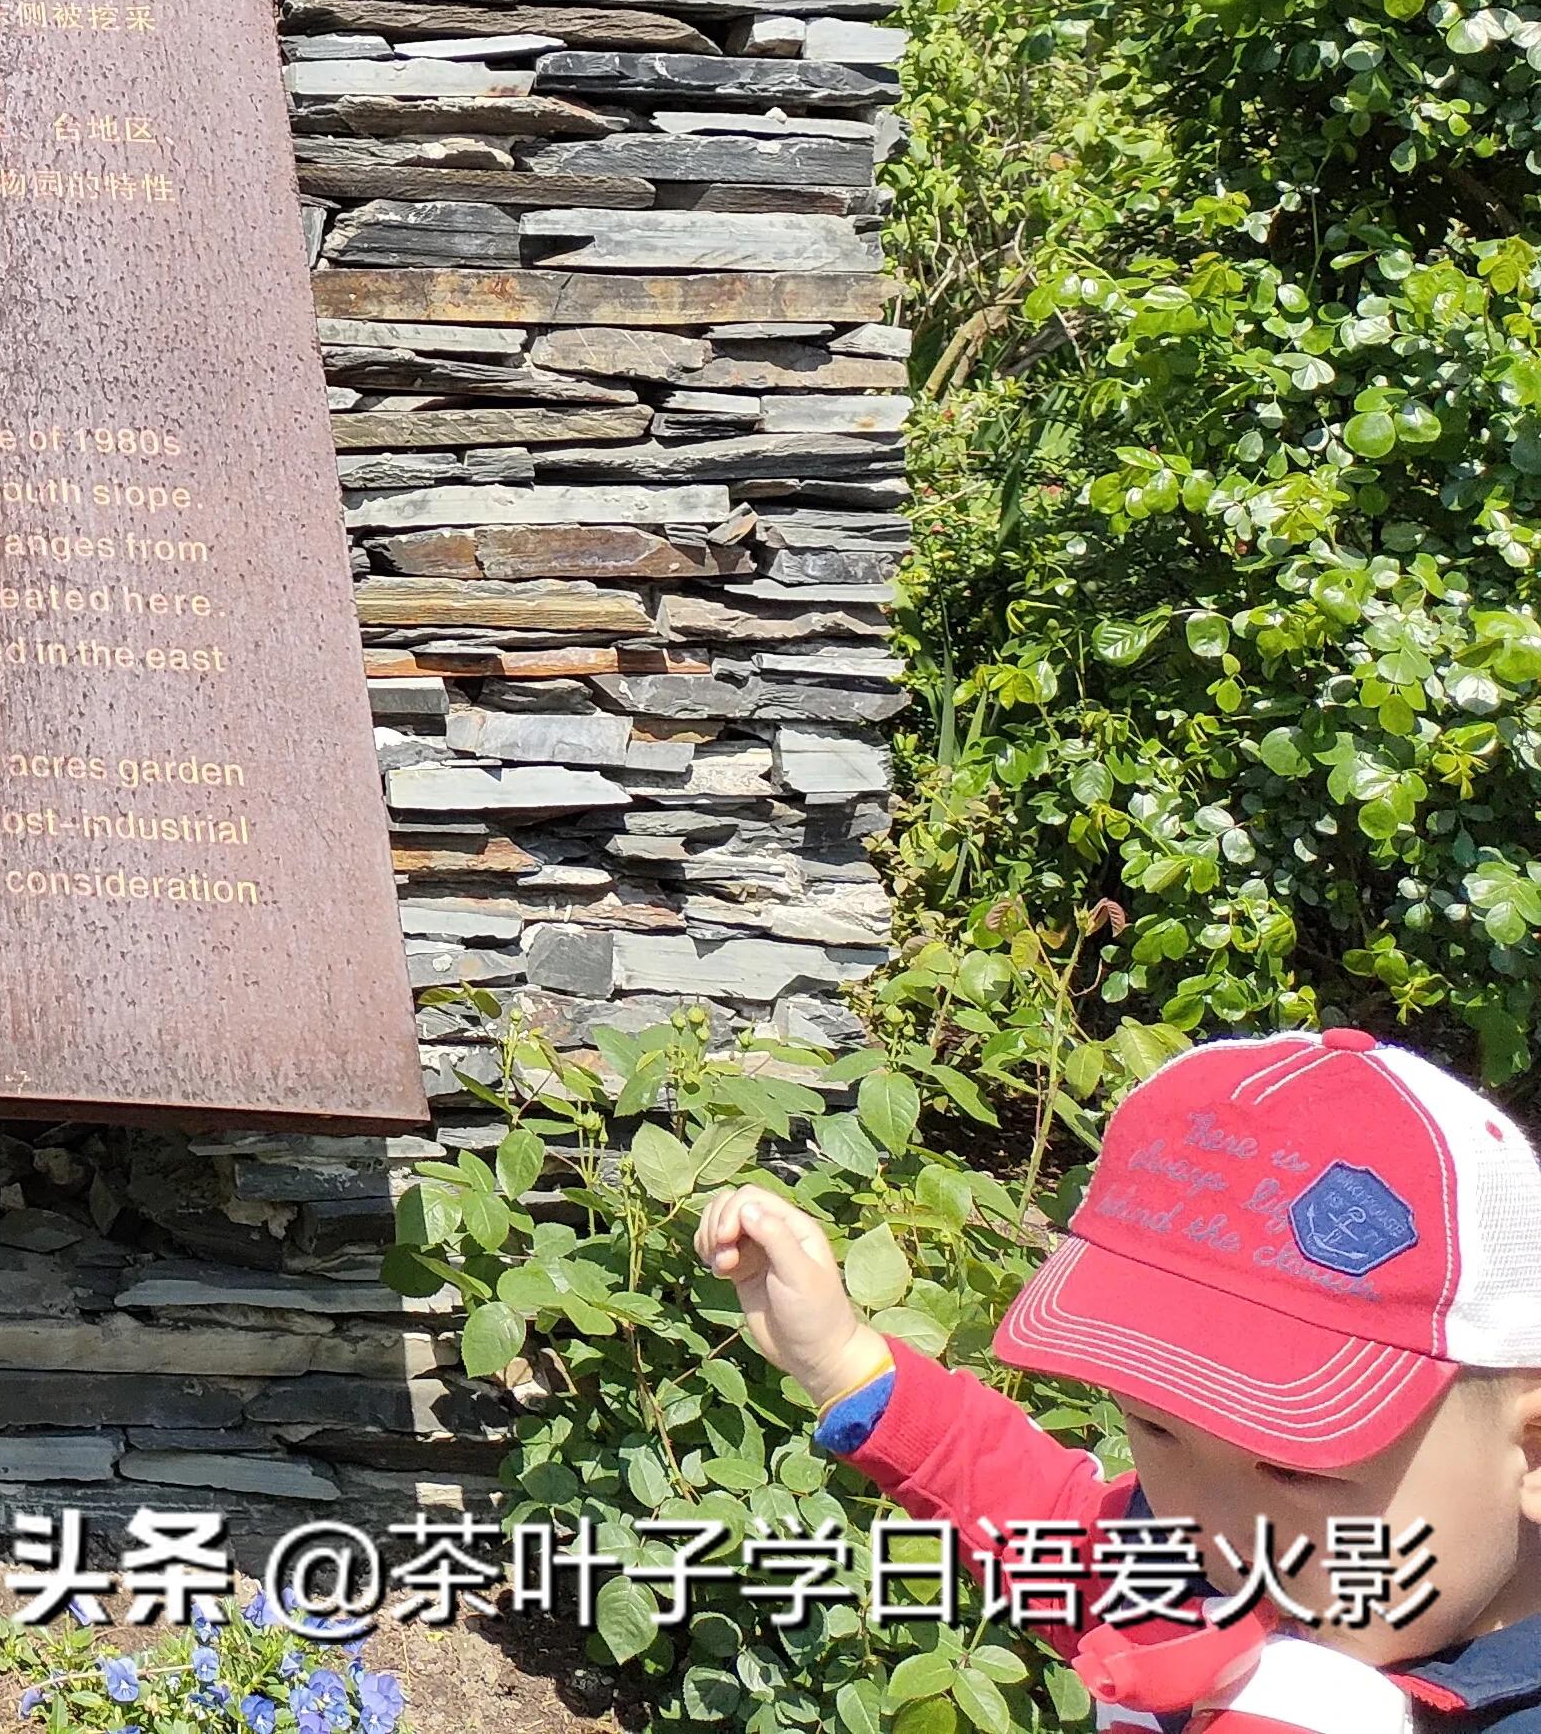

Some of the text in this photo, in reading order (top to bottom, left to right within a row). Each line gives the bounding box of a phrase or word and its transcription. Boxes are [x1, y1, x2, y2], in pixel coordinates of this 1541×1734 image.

[29, 426, 61, 452] of
[74, 428, 182, 456] 1980s
[92, 478, 205, 513] slope.
[126, 531, 209, 563] from
[122, 586, 226, 617] here.
[37, 638, 69, 666] in
[77, 640, 135, 670] the
[145, 646, 226, 673] east
[8, 753, 108, 781] acres
[118, 754, 245, 789] garden
[5, 867, 260, 906] consideration
